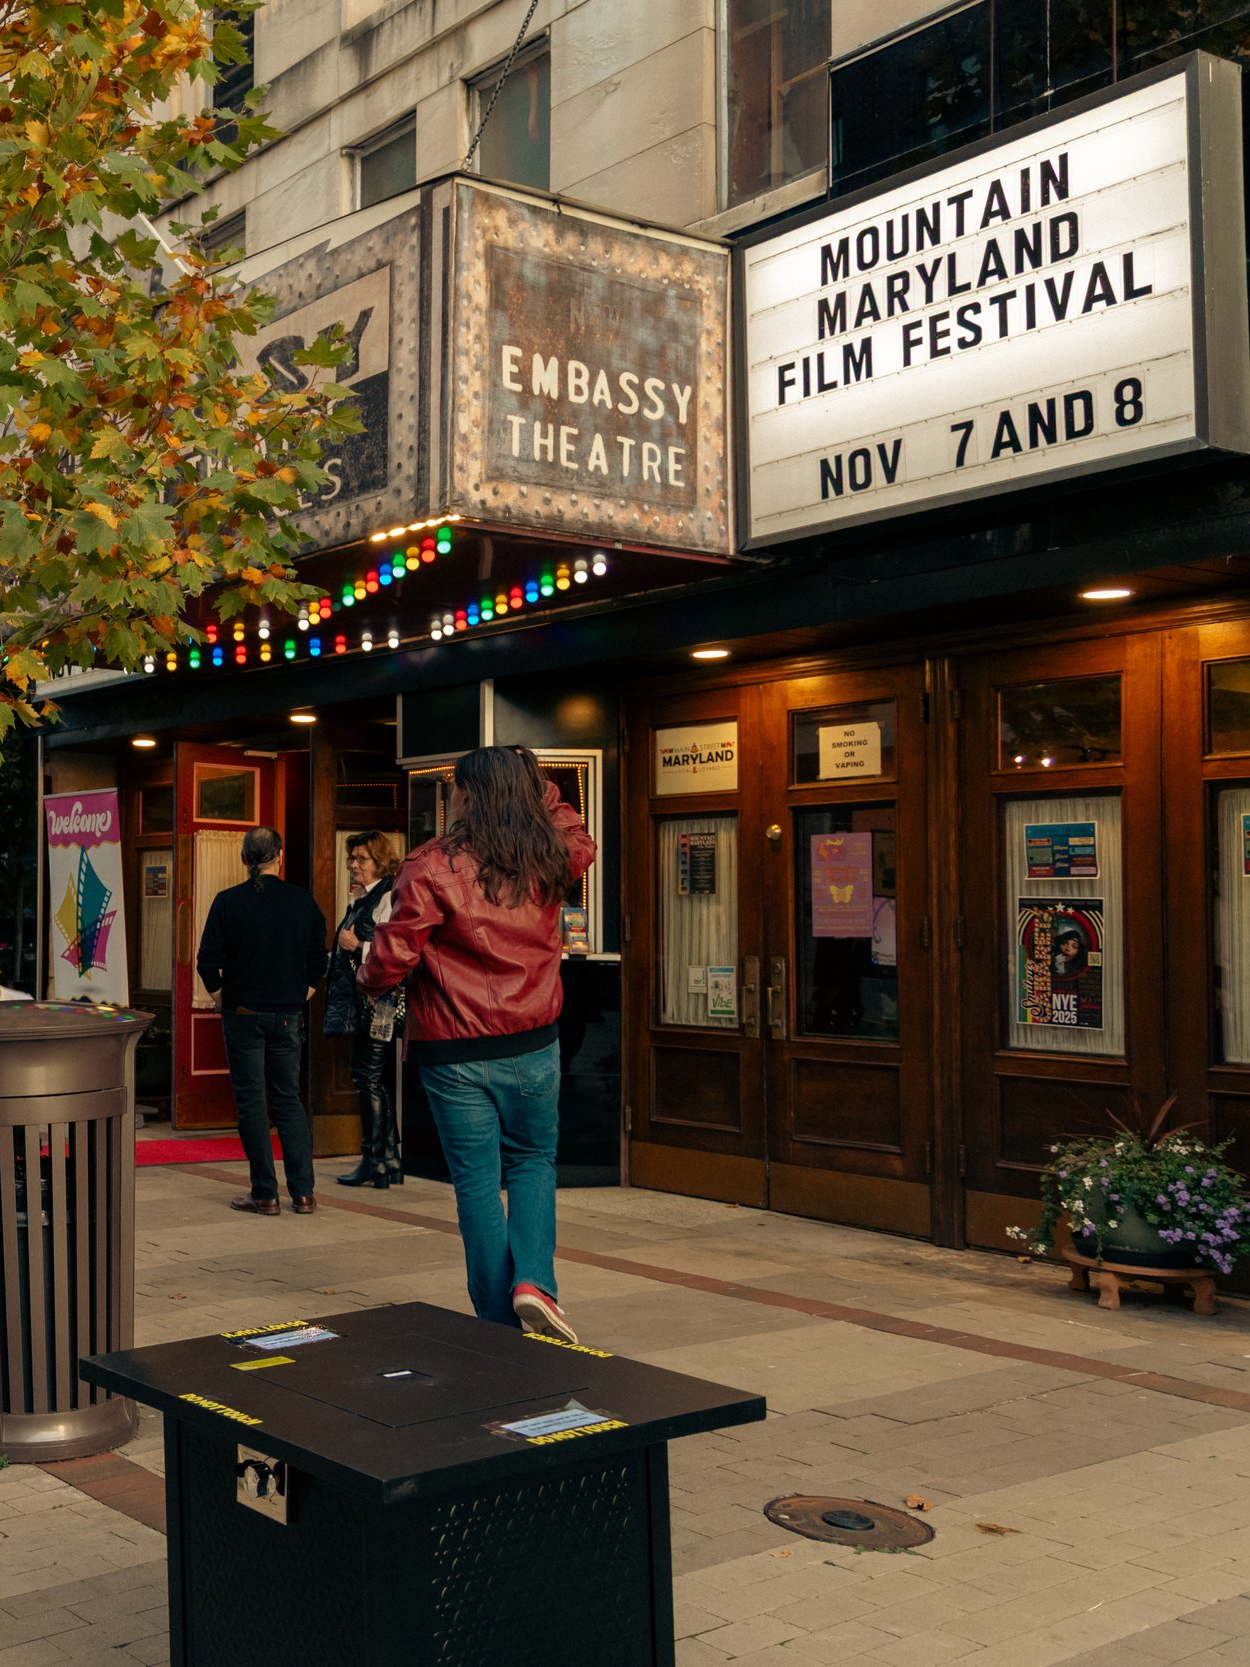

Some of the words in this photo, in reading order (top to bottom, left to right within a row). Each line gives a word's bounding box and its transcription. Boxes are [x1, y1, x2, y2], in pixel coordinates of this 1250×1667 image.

[819, 151, 1070, 287] MOUNTAIN
[816, 211, 1080, 341] MARYLAND
[777, 336, 873, 406] FILM
[901, 251, 1153, 368] FESTIVAL
[501, 344, 693, 425] EMBASSY
[819, 438, 903, 501] NOV
[950, 419, 975, 468] 7
[990, 389, 1094, 460] AND
[1113, 377, 1144, 427] 8
[506, 415, 687, 488] THEATRE
[699, 742, 720, 751] STREET
[831, 739, 868, 749] SMOKING
[844, 750, 855, 758] OR
[662, 749, 735, 768] MARYLAND
[835, 760, 865, 769] VAPING
[48, 801, 112, 838] welcome
[1052, 993, 1078, 1011] NYE
[1052, 1010, 1078, 1024] 2025
[216, 1408, 263, 1425] TOUCH
[526, 1435, 555, 1445] DO
[577, 1420, 630, 1434] TOUCH
